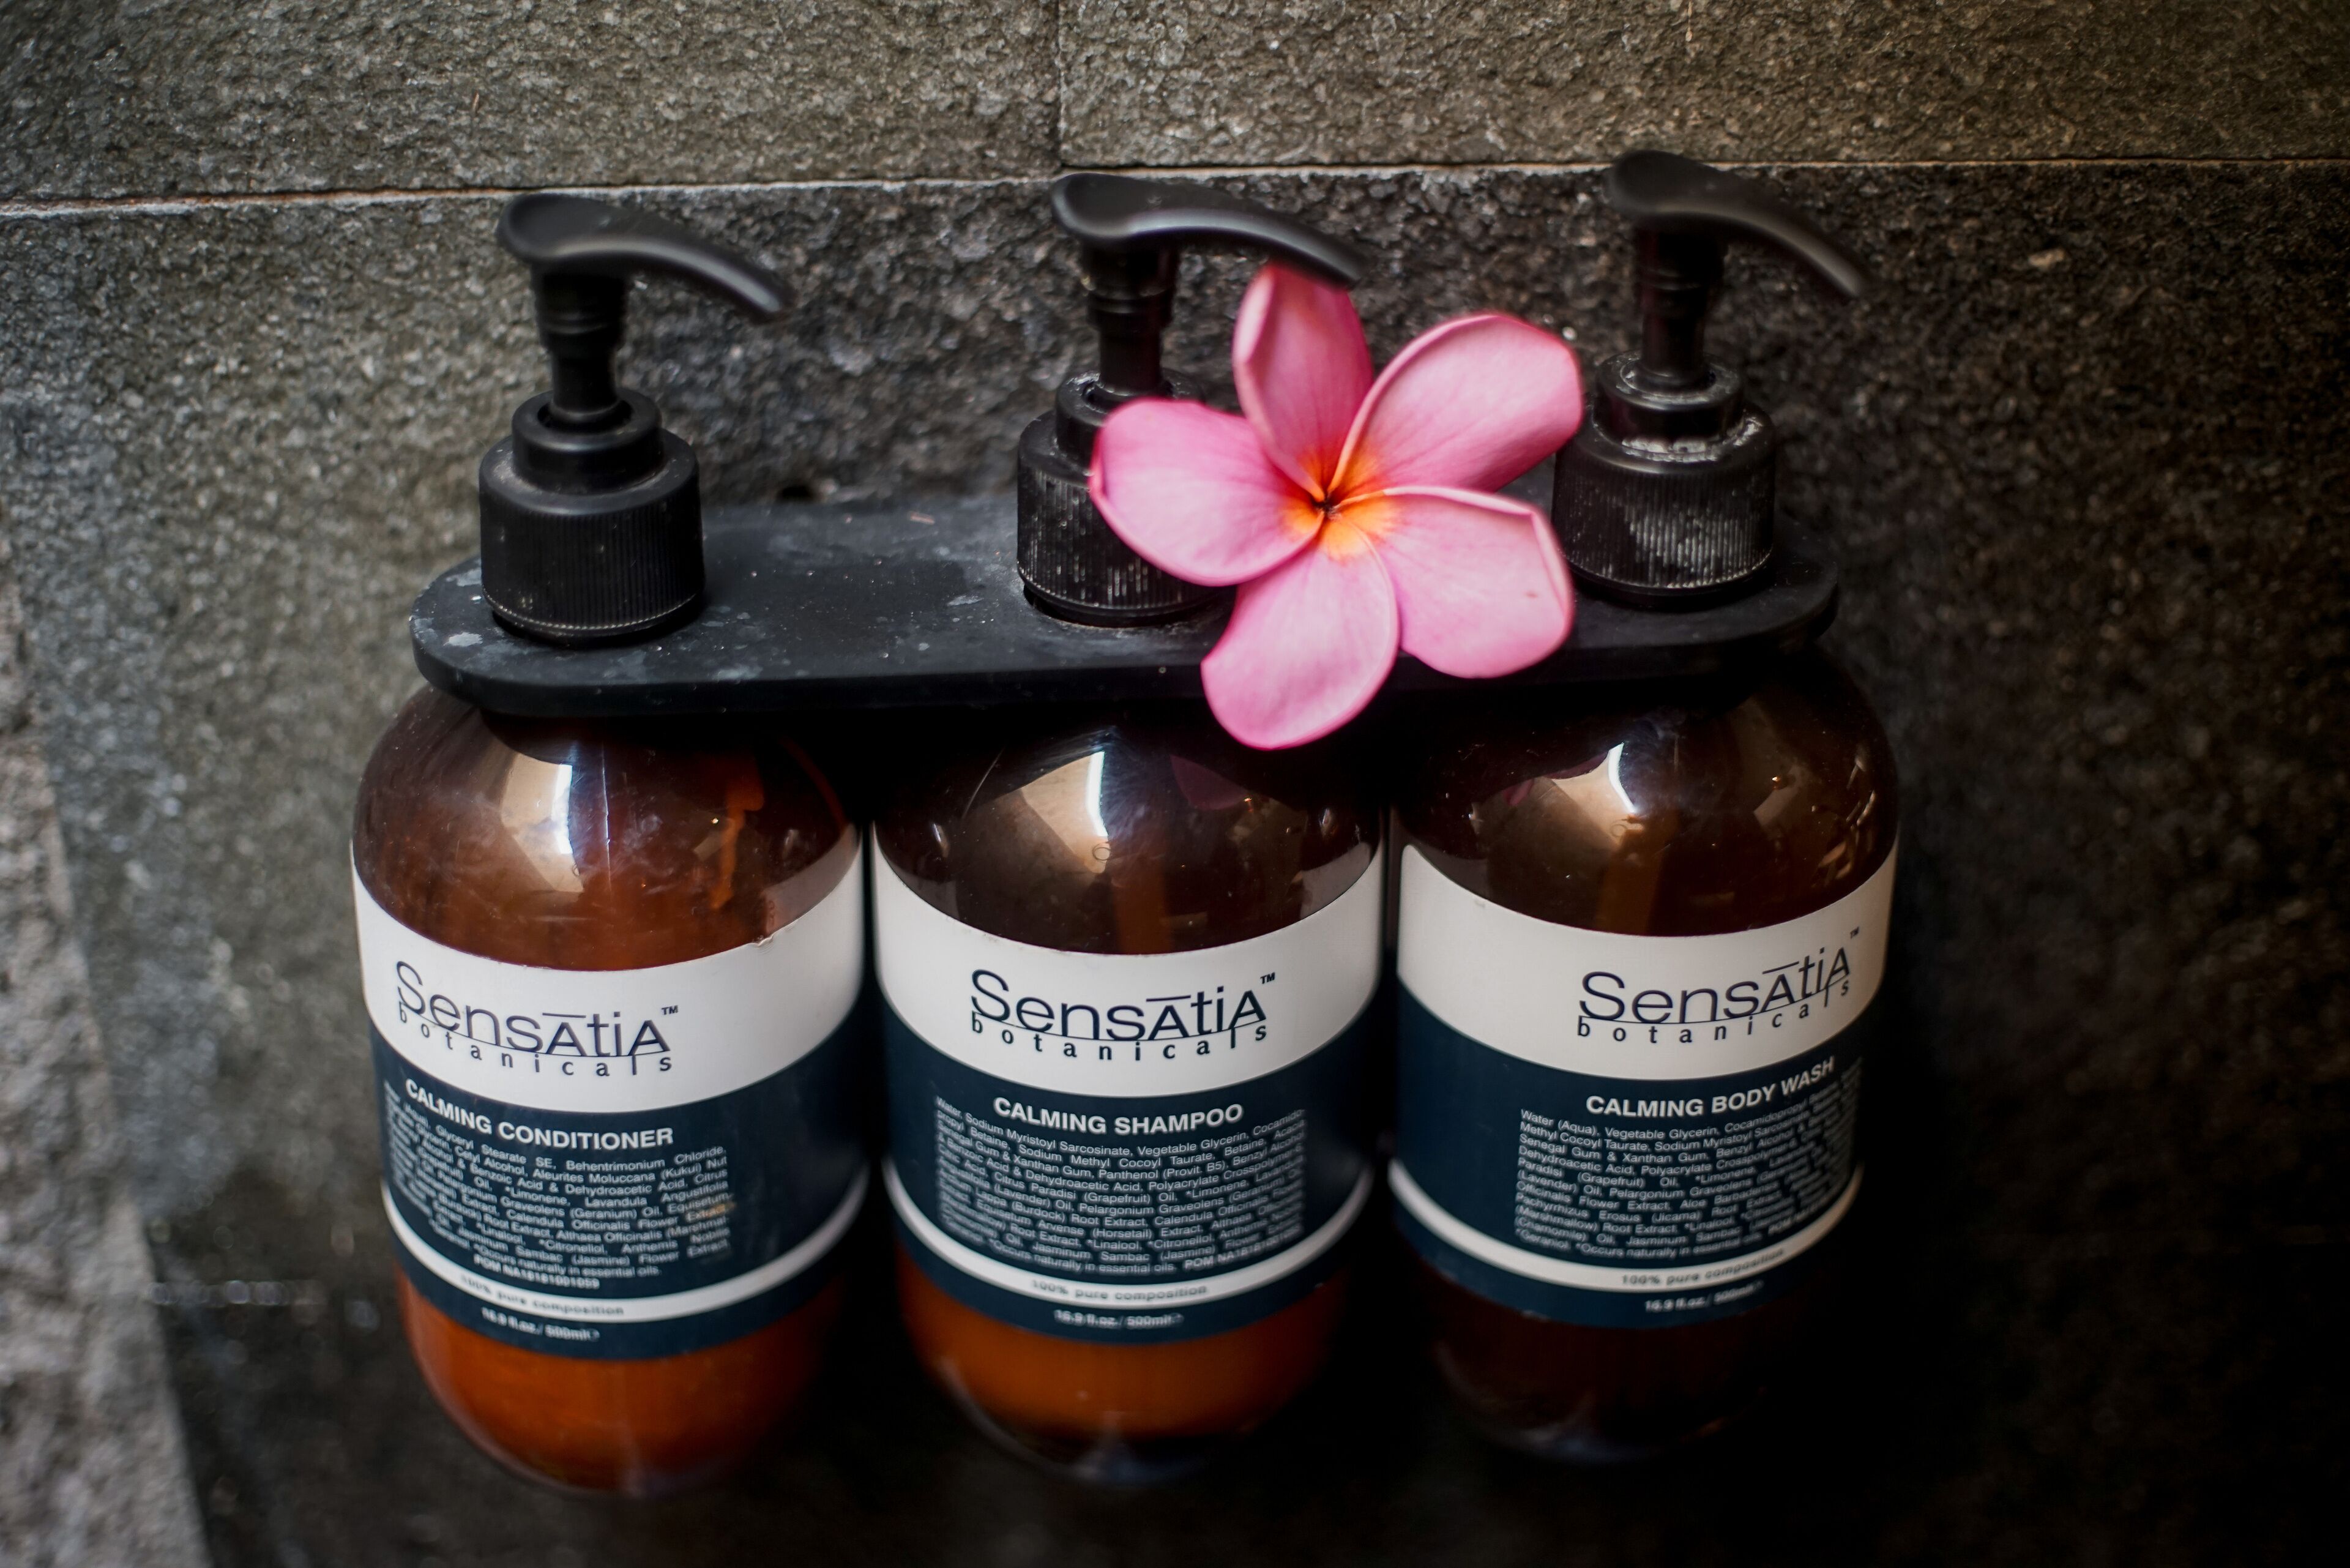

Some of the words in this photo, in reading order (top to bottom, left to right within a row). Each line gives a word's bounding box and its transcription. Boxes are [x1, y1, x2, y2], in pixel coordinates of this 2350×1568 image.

[1578, 980, 1849, 1043] botanicals
[399, 1001, 672, 1077] botanicals
[972, 1010, 1267, 1061] botanicals
[1586, 1096, 1704, 1118] CALMING
[1711, 1083, 1776, 1113] BODY
[1781, 1055, 1835, 1096] WASH
[406, 1078, 492, 1134] CALMING
[498, 1122, 673, 1150] CONDITIONER
[993, 1097, 1106, 1133] CALMING
[1114, 1103, 1243, 1134] SHAMPOO
[1521, 1109, 1554, 1126] Water
[1605, 1127, 1665, 1140] Vegetable
[1725, 1099, 1807, 1132] Cocamidopropyl
[964, 1113, 1004, 1135] Sodium
[1007, 1129, 1056, 1149] Myristoyl
[1060, 1141, 1133, 1156] Sarcosinate,
[1137, 1143, 1197, 1156] Vegetable
[1201, 1132, 1249, 1149] Glycerin,
[1253, 1109, 1305, 1135] Cocamido-
[1520, 1121, 1557, 1141] Methyl
[1560, 1132, 1601, 1149] Cocoyl
[1654, 1141, 1699, 1151] Sodium
[1703, 1131, 1753, 1148] Myristoyl
[436, 1125, 474, 1150] Glyceryl
[481, 1144, 527, 1165] Stearate
[565, 1159, 665, 1171] Behentrimonium
[970, 1127, 1010, 1150] Betaine,
[1018, 1144, 1062, 1162] Sodium
[1071, 1155, 1110, 1168] Methyl
[1119, 1157, 1161, 1169] Cocoyl
[1170, 1153, 1215, 1165] Taurate,
[975, 1141, 999, 1157] Gum
[1002, 1151, 1011, 1162] &
[1013, 1154, 1059, 1173] Xanthan
[1062, 1165, 1094, 1179] Gum,
[1099, 1169, 1158, 1181] Panthenol
[1232, 1149, 1267, 1167] Benzyl
[1519, 1146, 1601, 1171] Dehydroacetic
[1641, 1163, 1712, 1176] Polyacrylate
[1520, 1133, 1565, 1154] Senegal
[1572, 1147, 1600, 1159] Gum
[1607, 1151, 1617, 1160] &
[1622, 1153, 1671, 1163] Xanthan
[1716, 1142, 1753, 1157] Benzyl
[455, 1145, 480, 1163] Cetyl
[532, 1168, 584, 1183] Aleurites
[588, 1172, 655, 1184] Moluccana
[660, 1163, 702, 1180] (Kukui)
[706, 1156, 727, 1170] Nut
[947, 1138, 984, 1163] Benzoic
[987, 1157, 1010, 1173] Acid
[1013, 1166, 1022, 1177] &
[1025, 1170, 1109, 1190] Dehydroacetic
[1149, 1175, 1220, 1191] Polyacrylate
[1518, 1157, 1564, 1178] Paradisi
[1578, 1171, 1645, 1189] (Grapefruit)
[470, 1163, 512, 1185] Benzoic
[517, 1178, 543, 1191] Acid
[549, 1182, 559, 1193] &
[564, 1184, 652, 1197] Dehydroacetic
[693, 1169, 728, 1184] Citrus
[993, 1171, 1025, 1190] Citrus
[1031, 1182, 1076, 1199] Paradisi
[1084, 1192, 1151, 1206] (Grapefruit)
[1518, 1169, 1578, 1192] (Lavender)
[1610, 1187, 1684, 1201] Pelargonium
[1690, 1178, 1753, 1197] Graveolens
[499, 1196, 565, 1217] Graveolens
[569, 1208, 637, 1220] (Geranium)
[584, 1197, 647, 1208] Lavandula
[975, 1187, 1007, 1207] Lappa
[1012, 1201, 1065, 1222] (Burdock)
[1071, 1214, 1099, 1225] Root
[1154, 1211, 1213, 1226] Calendula
[1218, 1195, 1269, 1215] Officinalis
[994, 1184, 1051, 1208] (Lavender)
[1079, 1203, 1154, 1216] Pelargonium
[1158, 1197, 1224, 1214] Graveolens
[1579, 1196, 1619, 1209] Flower
[1680, 1199, 1707, 1209] Aloe
[506, 1209, 564, 1228] Calendula
[571, 1219, 630, 1231] Officinalis
[637, 1216, 679, 1229] Flower
[1010, 1223, 1035, 1238] Root
[1038, 1219, 1084, 1236] Arvense
[1092, 1228, 1152, 1239] (Horsetail)
[1599, 1210, 1641, 1222] Erosus
[1652, 1211, 1703, 1223] (Jicama)
[1603, 1222, 1632, 1233] Root
[603, 1230, 663, 1244] Officinalis
[621, 1239, 679, 1255] Anthemis
[1032, 1242, 1091, 1259] Jasminum
[1100, 1251, 1150, 1261] Sambac
[1160, 1245, 1216, 1261] (Jasmine)
[1626, 1236, 1687, 1246] Jasminum
[638, 1252, 680, 1264] Flower
[1034, 1254, 1081, 1271] naturally
[1085, 1263, 1095, 1272] in
[1099, 1263, 1151, 1272] essential
[1184, 1255, 1214, 1270] POM
[1622, 1274, 1660, 1285] 100%
[1666, 1272, 1699, 1285] pure
[1704, 1248, 1784, 1280] composition
[1627, 1247, 1676, 1259] naturally
[567, 1266, 580, 1276] in
[498, 1290, 527, 1305] pure
[532, 1300, 624, 1315] composition
[1032, 1279, 1069, 1294] 100%
[1075, 1290, 1108, 1299] pure
[1115, 1286, 1207, 1301] composition
[1054, 1310, 1084, 1326] 16.9
